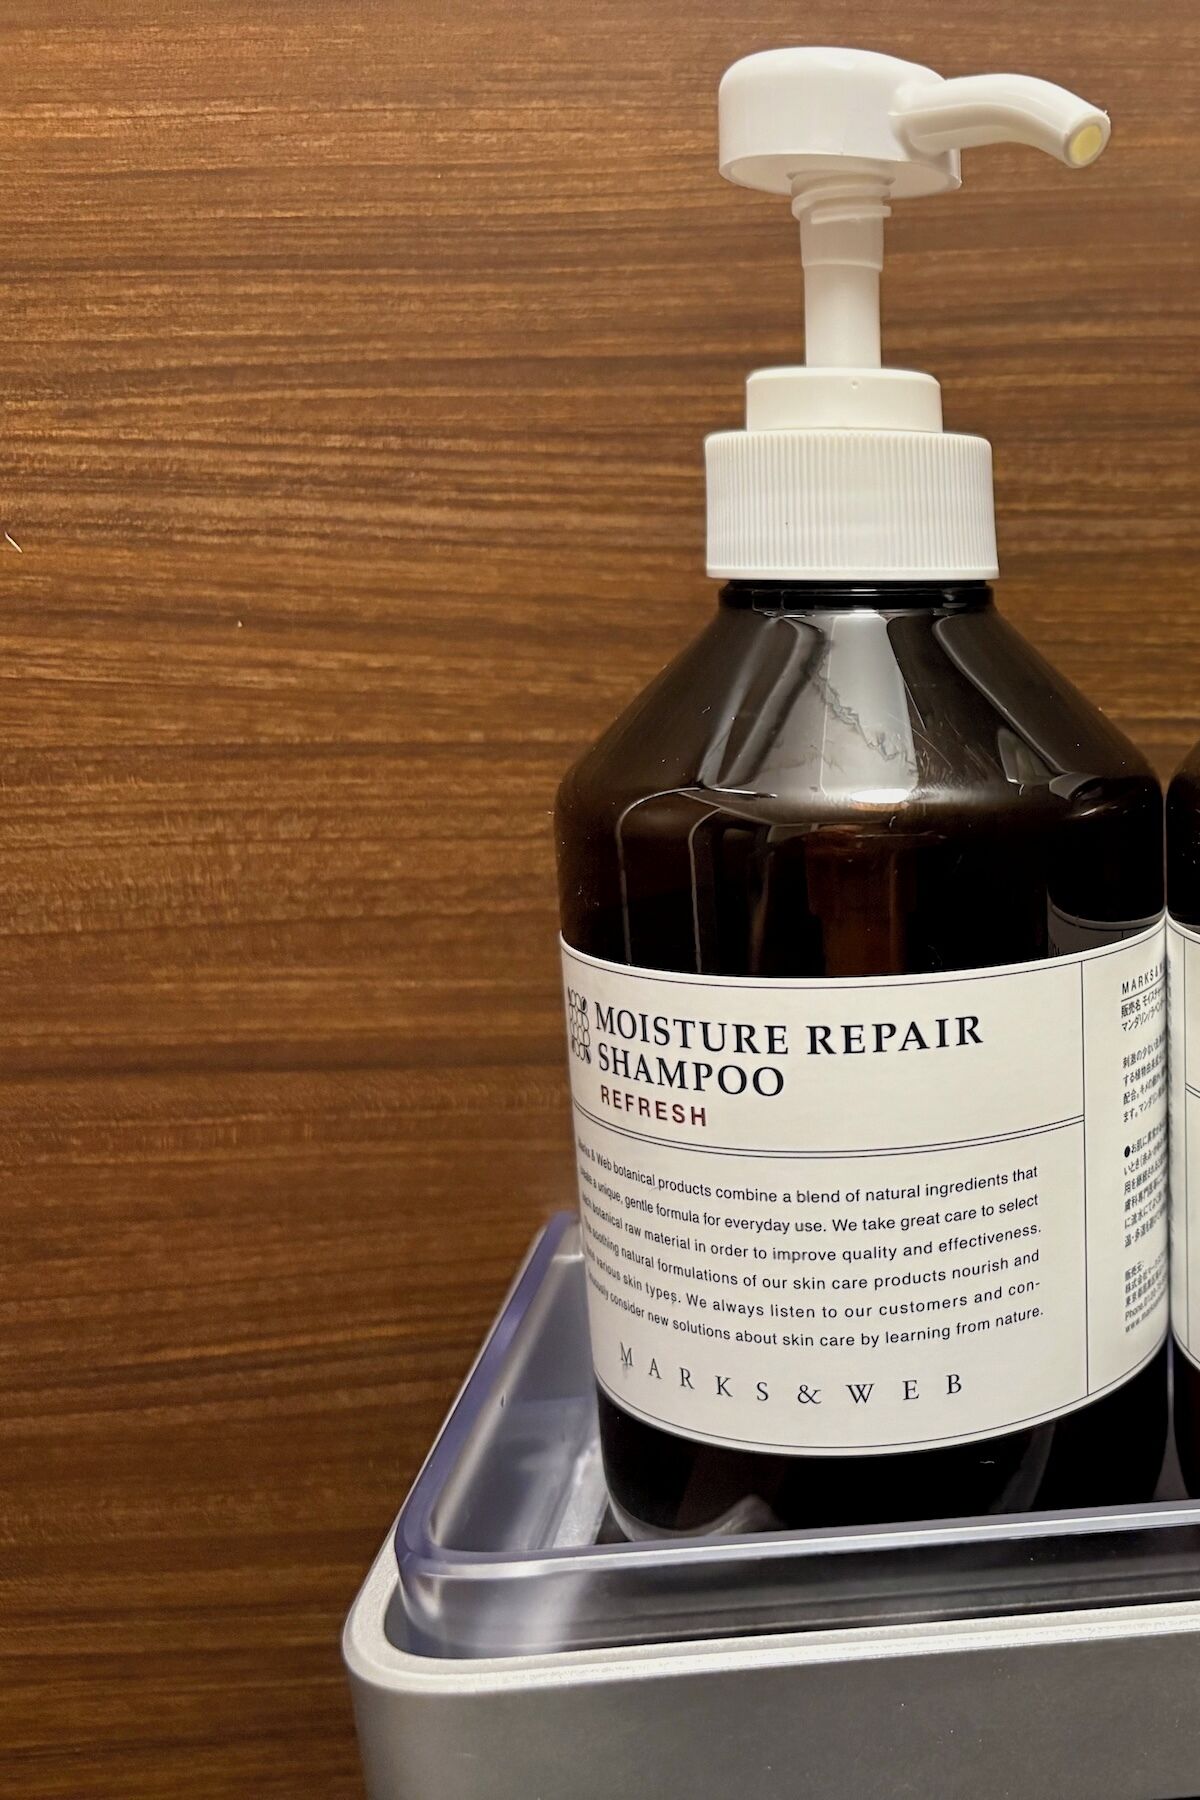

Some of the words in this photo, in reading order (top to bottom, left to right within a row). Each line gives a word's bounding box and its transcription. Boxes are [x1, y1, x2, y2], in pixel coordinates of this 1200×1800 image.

[594, 1001, 788, 1055] MOISTURE
[805, 1016, 984, 1055] REPAIR
[598, 1042, 784, 1097] SHAMPOO
[601, 1085, 706, 1127] REFRESH
[596, 1152, 612, 1171] Web
[613, 1161, 656, 1187] botanical
[658, 1178, 712, 1197] products
[715, 1188, 778, 1203] combine
[782, 1192, 792, 1203] a
[796, 1189, 840, 1204] blend
[845, 1188, 861, 1203] of
[865, 1184, 920, 1202] natural
[925, 1173, 1009, 1198] ingredients
[1012, 1166, 1038, 1182] that
[624, 1196, 654, 1214] gentle
[655, 1202, 700, 1224] formula
[702, 1212, 721, 1227] for
[724, 1218, 790, 1235] everyday
[794, 1222, 827, 1233] use.
[831, 1218, 858, 1232] We
[862, 1217, 896, 1231] take
[900, 1212, 941, 1232] great
[944, 1209, 977, 1223] care
[981, 1205, 995, 1217] to
[998, 1193, 1038, 1214] select
[624, 1222, 642, 1237] raw
[644, 1230, 691, 1250] material
[694, 1238, 706, 1253] in
[710, 1243, 749, 1258] order
[753, 1247, 767, 1260] to
[772, 1247, 836, 1264] improve
[842, 1246, 897, 1264] quality
[903, 1241, 933, 1257] and
[938, 1224, 1041, 1253] effectiveness.
[621, 1247, 654, 1268] natural
[657, 1258, 738, 1286] formulations
[743, 1274, 757, 1287] of
[762, 1278, 788, 1289] our
[793, 1276, 826, 1290] skin
[831, 1278, 868, 1290] care
[874, 1270, 946, 1291] products
[952, 1257, 1009, 1279] nourish
[1014, 1248, 1039, 1267] and
[623, 1274, 642, 1291] skin
[645, 1282, 681, 1305] types.
[685, 1292, 707, 1309] We
[712, 1299, 764, 1318] always
[770, 1304, 815, 1319] listen
[821, 1306, 838, 1319] to
[844, 1306, 873, 1318] our
[878, 1296, 968, 1316] customers
[974, 1285, 1002, 1304] and
[1008, 1281, 1040, 1296] con-
[610, 1293, 645, 1318] consider
[647, 1312, 669, 1327] new
[672, 1319, 731, 1340] solutions
[735, 1330, 778, 1345] about
[782, 1333, 814, 1347] skin
[819, 1336, 855, 1347] care
[861, 1332, 880, 1348] by
[885, 1326, 951, 1344] learning
[956, 1320, 990, 1335] from
[995, 1307, 1044, 1327] nature.
